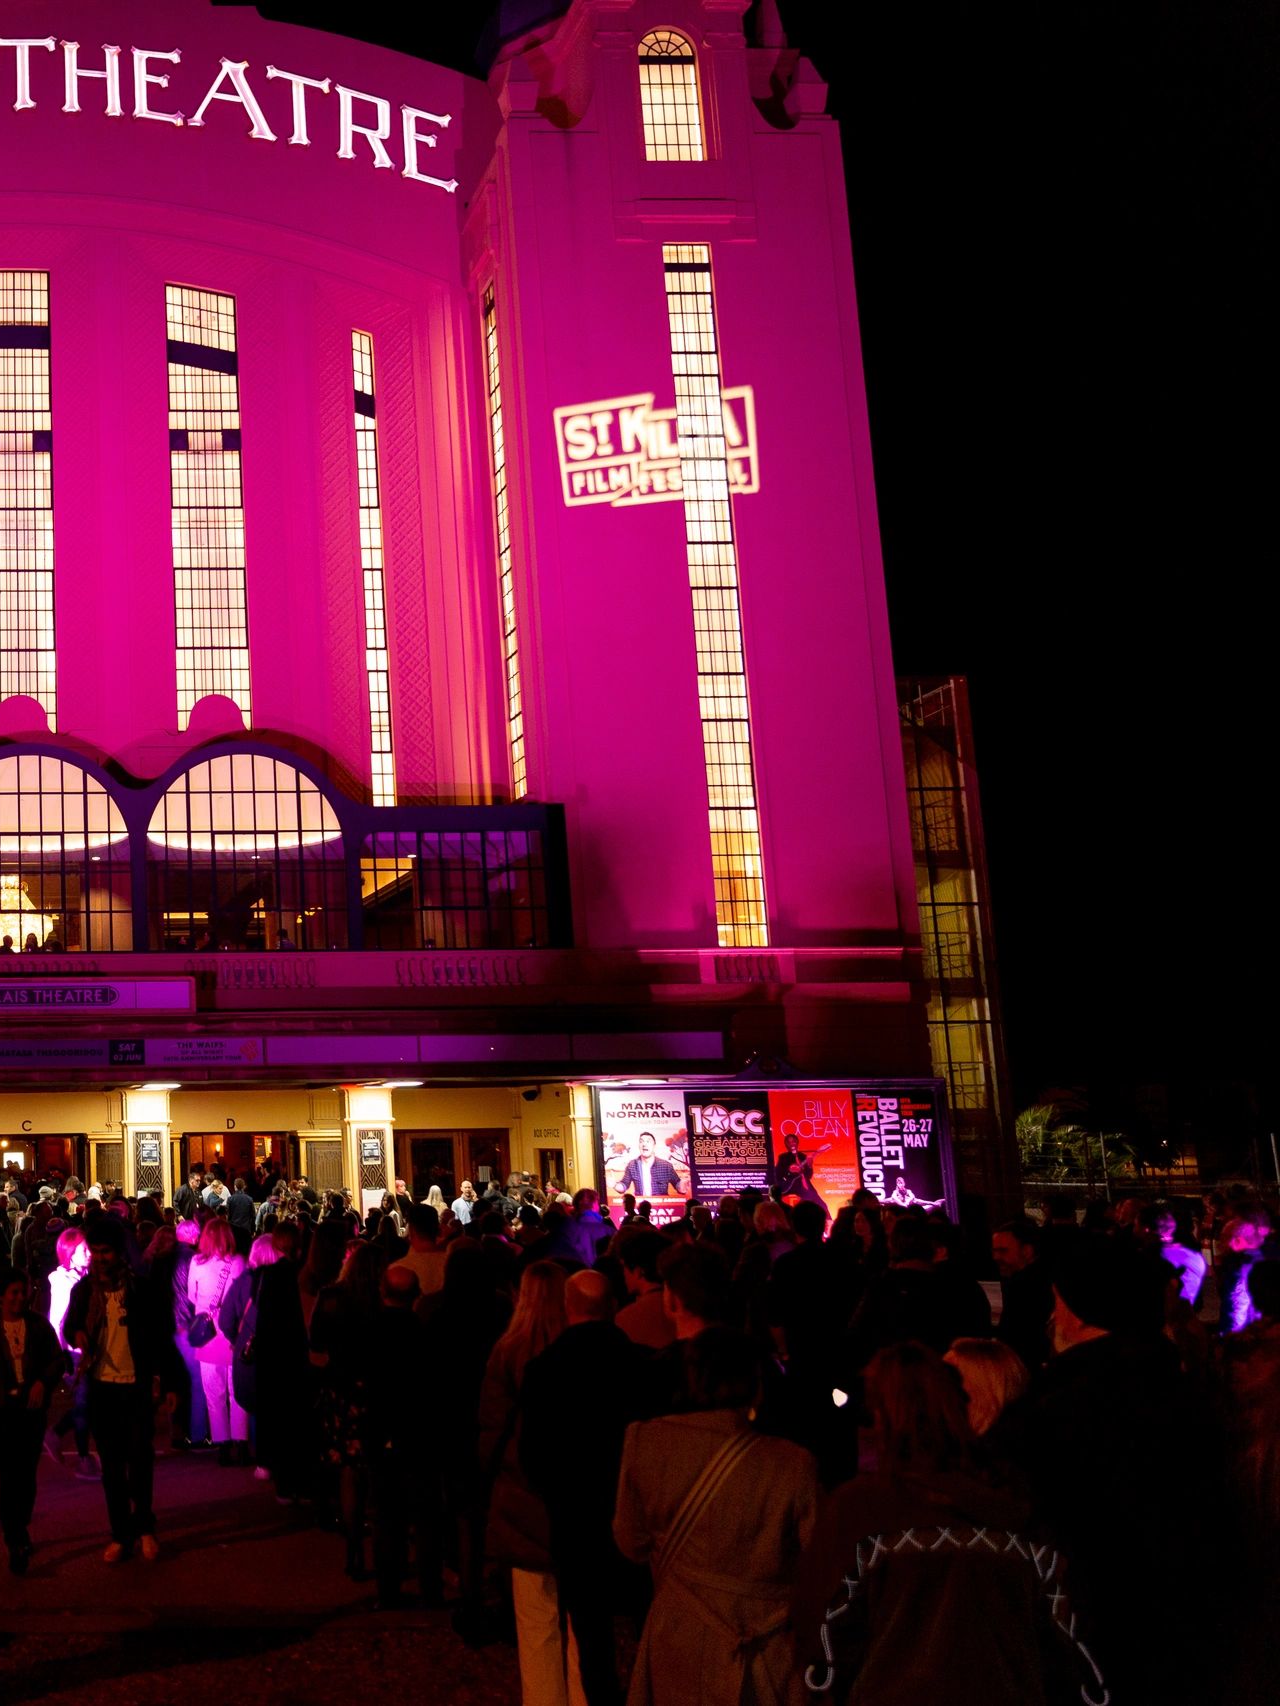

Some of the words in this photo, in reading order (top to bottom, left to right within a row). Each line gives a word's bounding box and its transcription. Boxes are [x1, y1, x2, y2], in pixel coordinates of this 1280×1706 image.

[619, 402, 742, 460] KIL
[572, 467, 631, 496] FILM
[33, 989, 103, 1003] THEATRE
[118, 1043, 136, 1052] SAT
[621, 1102, 665, 1110] MARK
[804, 1100, 849, 1119] BILLY
[606, 1110, 682, 1118] NORMAND
[22, 1120, 32, 1131] C
[226, 1118, 235, 1129] D
[780, 1119, 850, 1138] OCEAN
[902, 1119, 933, 1133] 26-27
[877, 1098, 905, 1170] BALLET
[903, 1133, 929, 1148] MAY
[693, 1139, 767, 1148] GREATEST
[856, 1098, 887, 1203] REVOLUCI
[694, 1147, 726, 1157] HITS
[728, 1147, 767, 1157] TOUR
